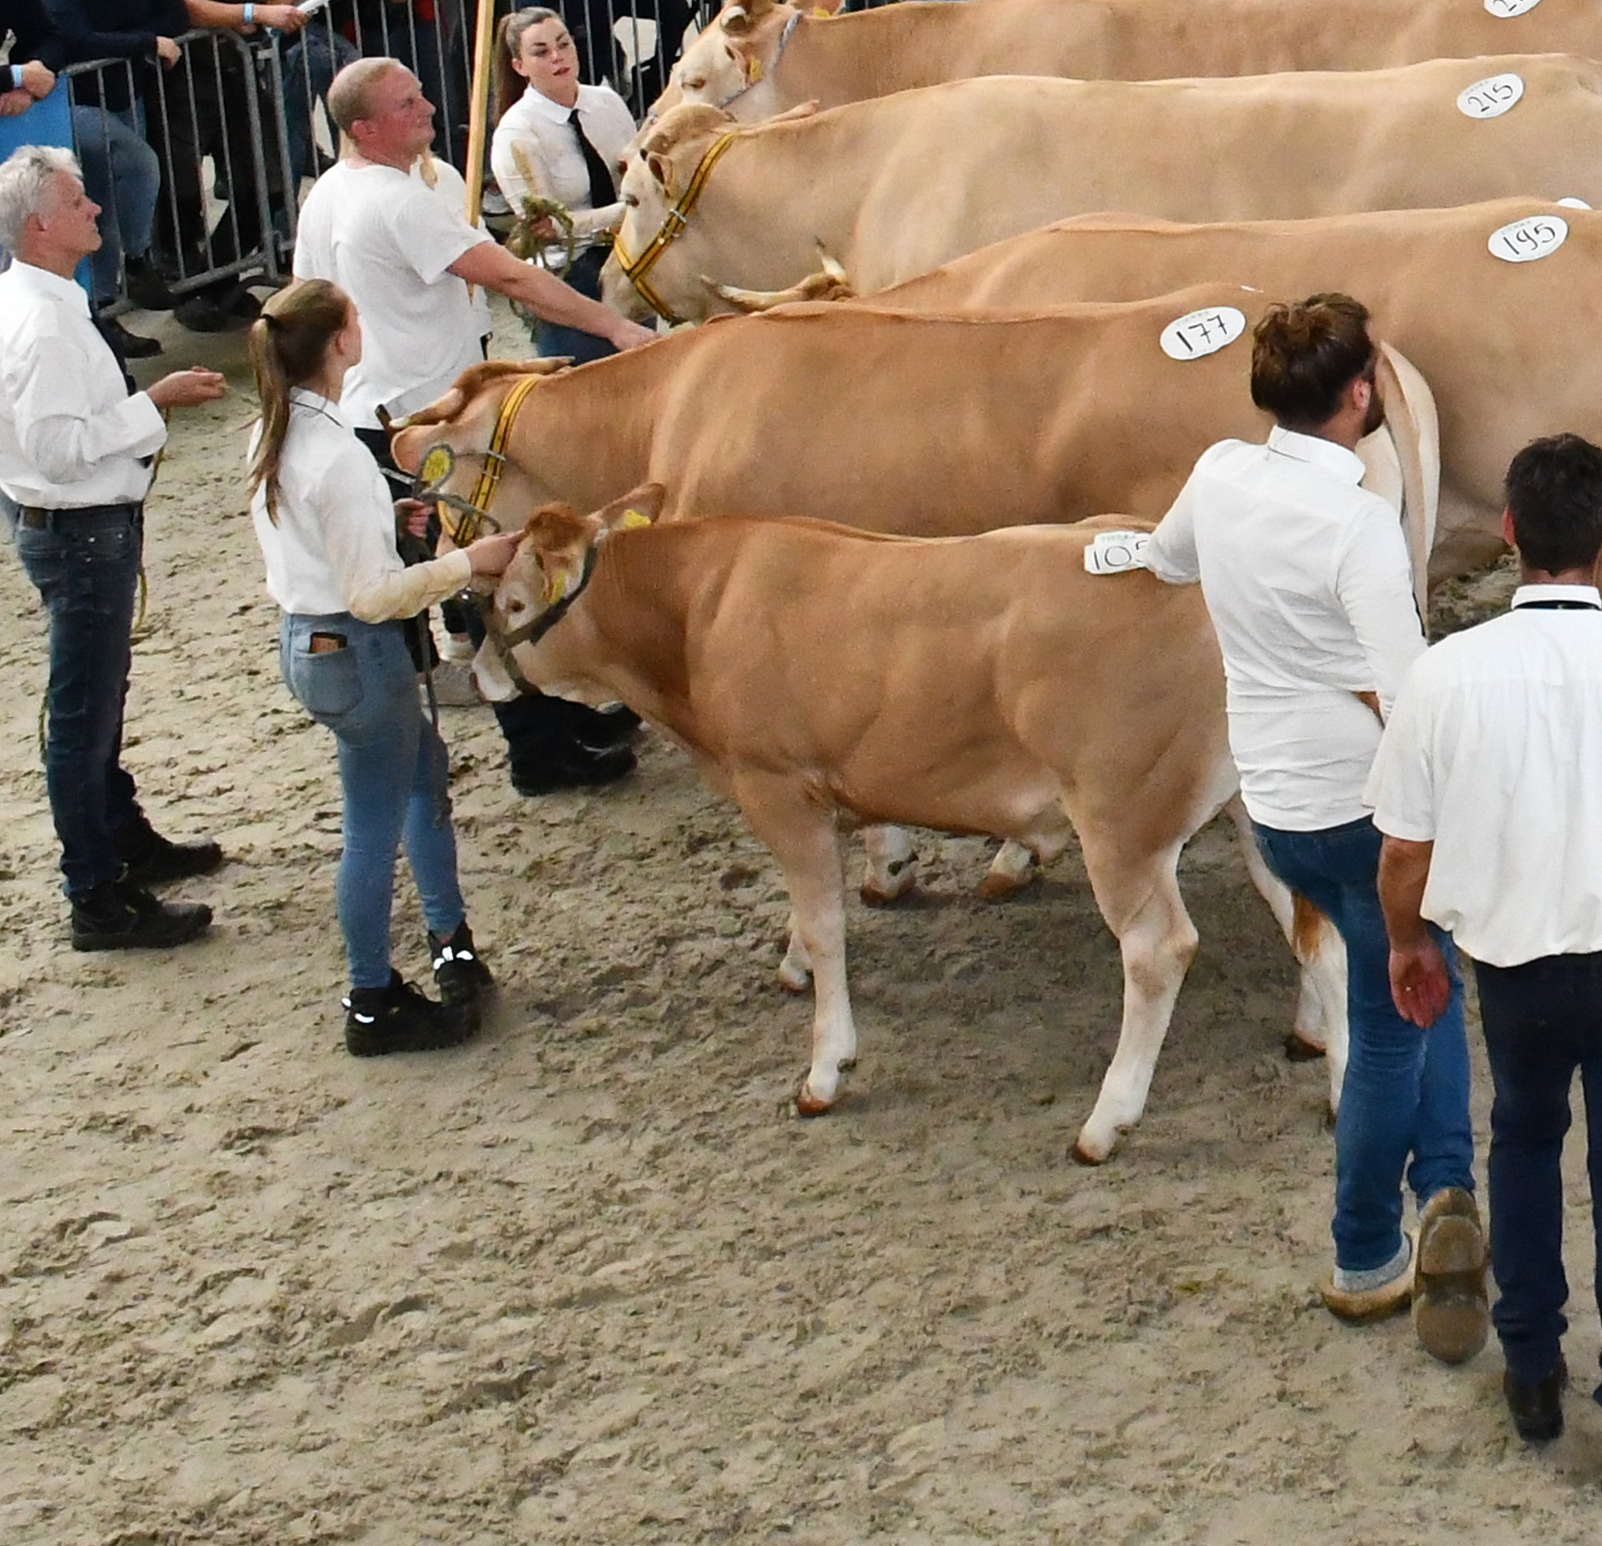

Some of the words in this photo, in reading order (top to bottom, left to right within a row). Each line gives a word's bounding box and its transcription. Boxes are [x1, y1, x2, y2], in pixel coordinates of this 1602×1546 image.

[1467, 82, 1514, 113] 215
[1503, 223, 1556, 256] 195
[1177, 314, 1228, 353] 177
